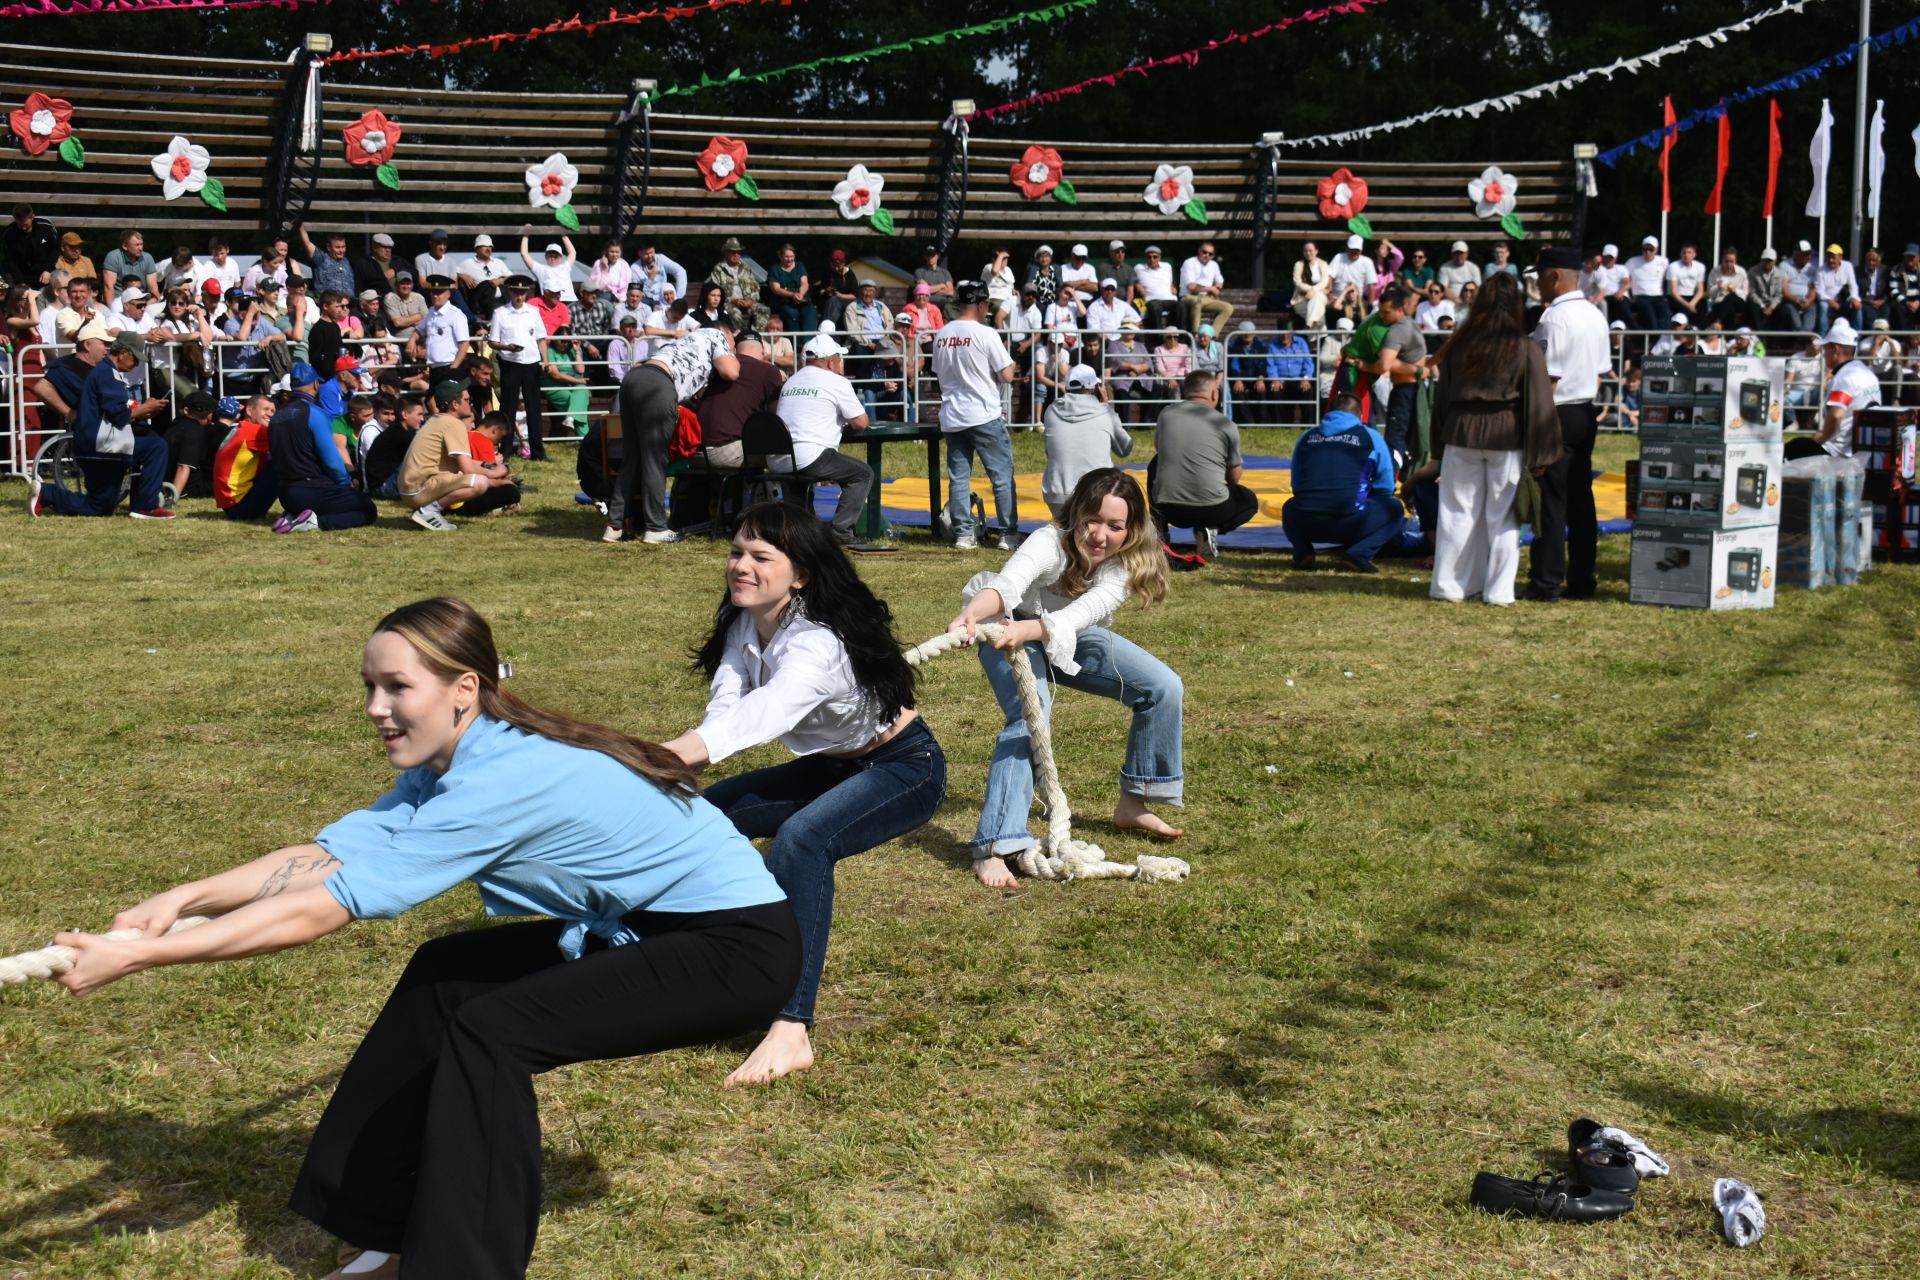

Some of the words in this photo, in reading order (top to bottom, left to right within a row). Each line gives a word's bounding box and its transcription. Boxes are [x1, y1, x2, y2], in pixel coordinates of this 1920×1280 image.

[937, 336, 971, 349] СУДЬЯ
[1643, 360, 1673, 370] gorenje
[1642, 446, 1671, 455] gorenje
[1633, 529, 1661, 539] gorenje
